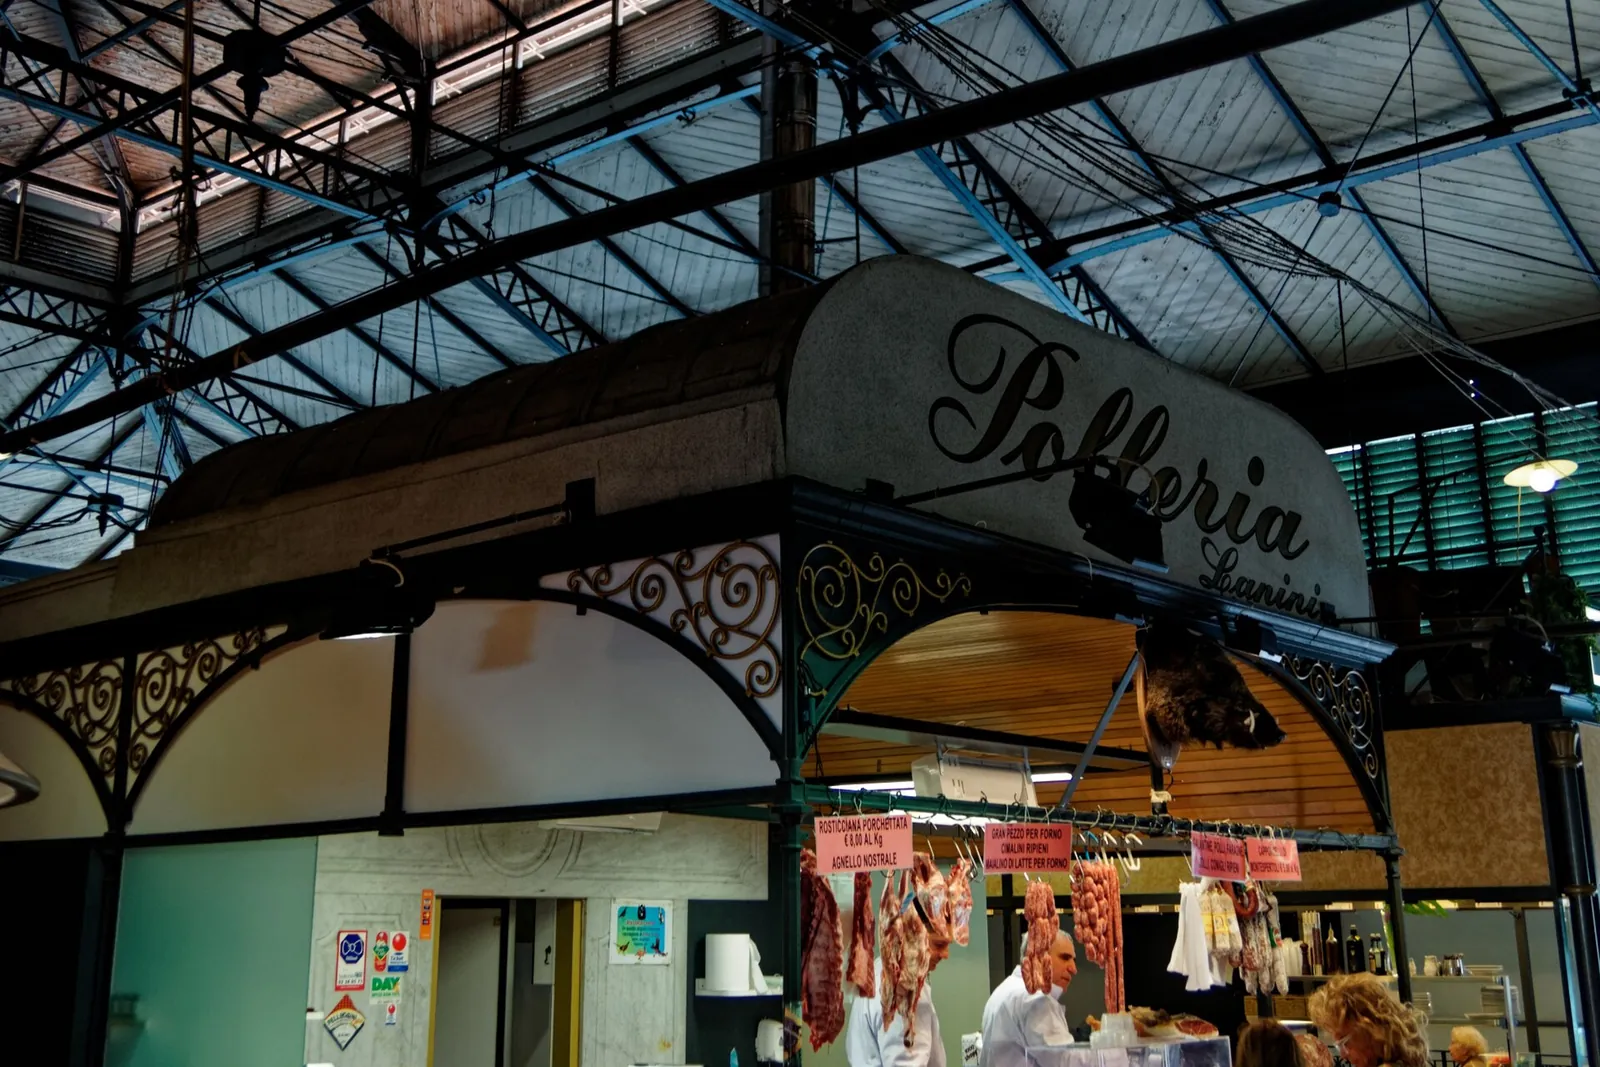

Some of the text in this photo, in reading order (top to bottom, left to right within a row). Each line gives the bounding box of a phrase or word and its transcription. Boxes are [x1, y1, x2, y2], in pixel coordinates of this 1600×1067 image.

[928, 313, 1310, 561] Polleria
[1198, 537, 1322, 618] Lanini
[819, 817, 908, 834] ROSTICCIANA PORCHETTATA
[844, 833, 883, 848] € 8,00 AL Kg
[991, 828, 1062, 840] GRAN PEZZO PER FORNO
[1026, 843, 1049, 854] RIPIENI
[832, 852, 897, 870] AGNELLO NOSTRALE
[1008, 858, 1013, 869] DI
[1015, 858, 1032, 869] LATTE
[1034, 858, 1046, 869] PER
[1047, 858, 1068, 869] FORNO
[371, 976, 401, 992] DAY
